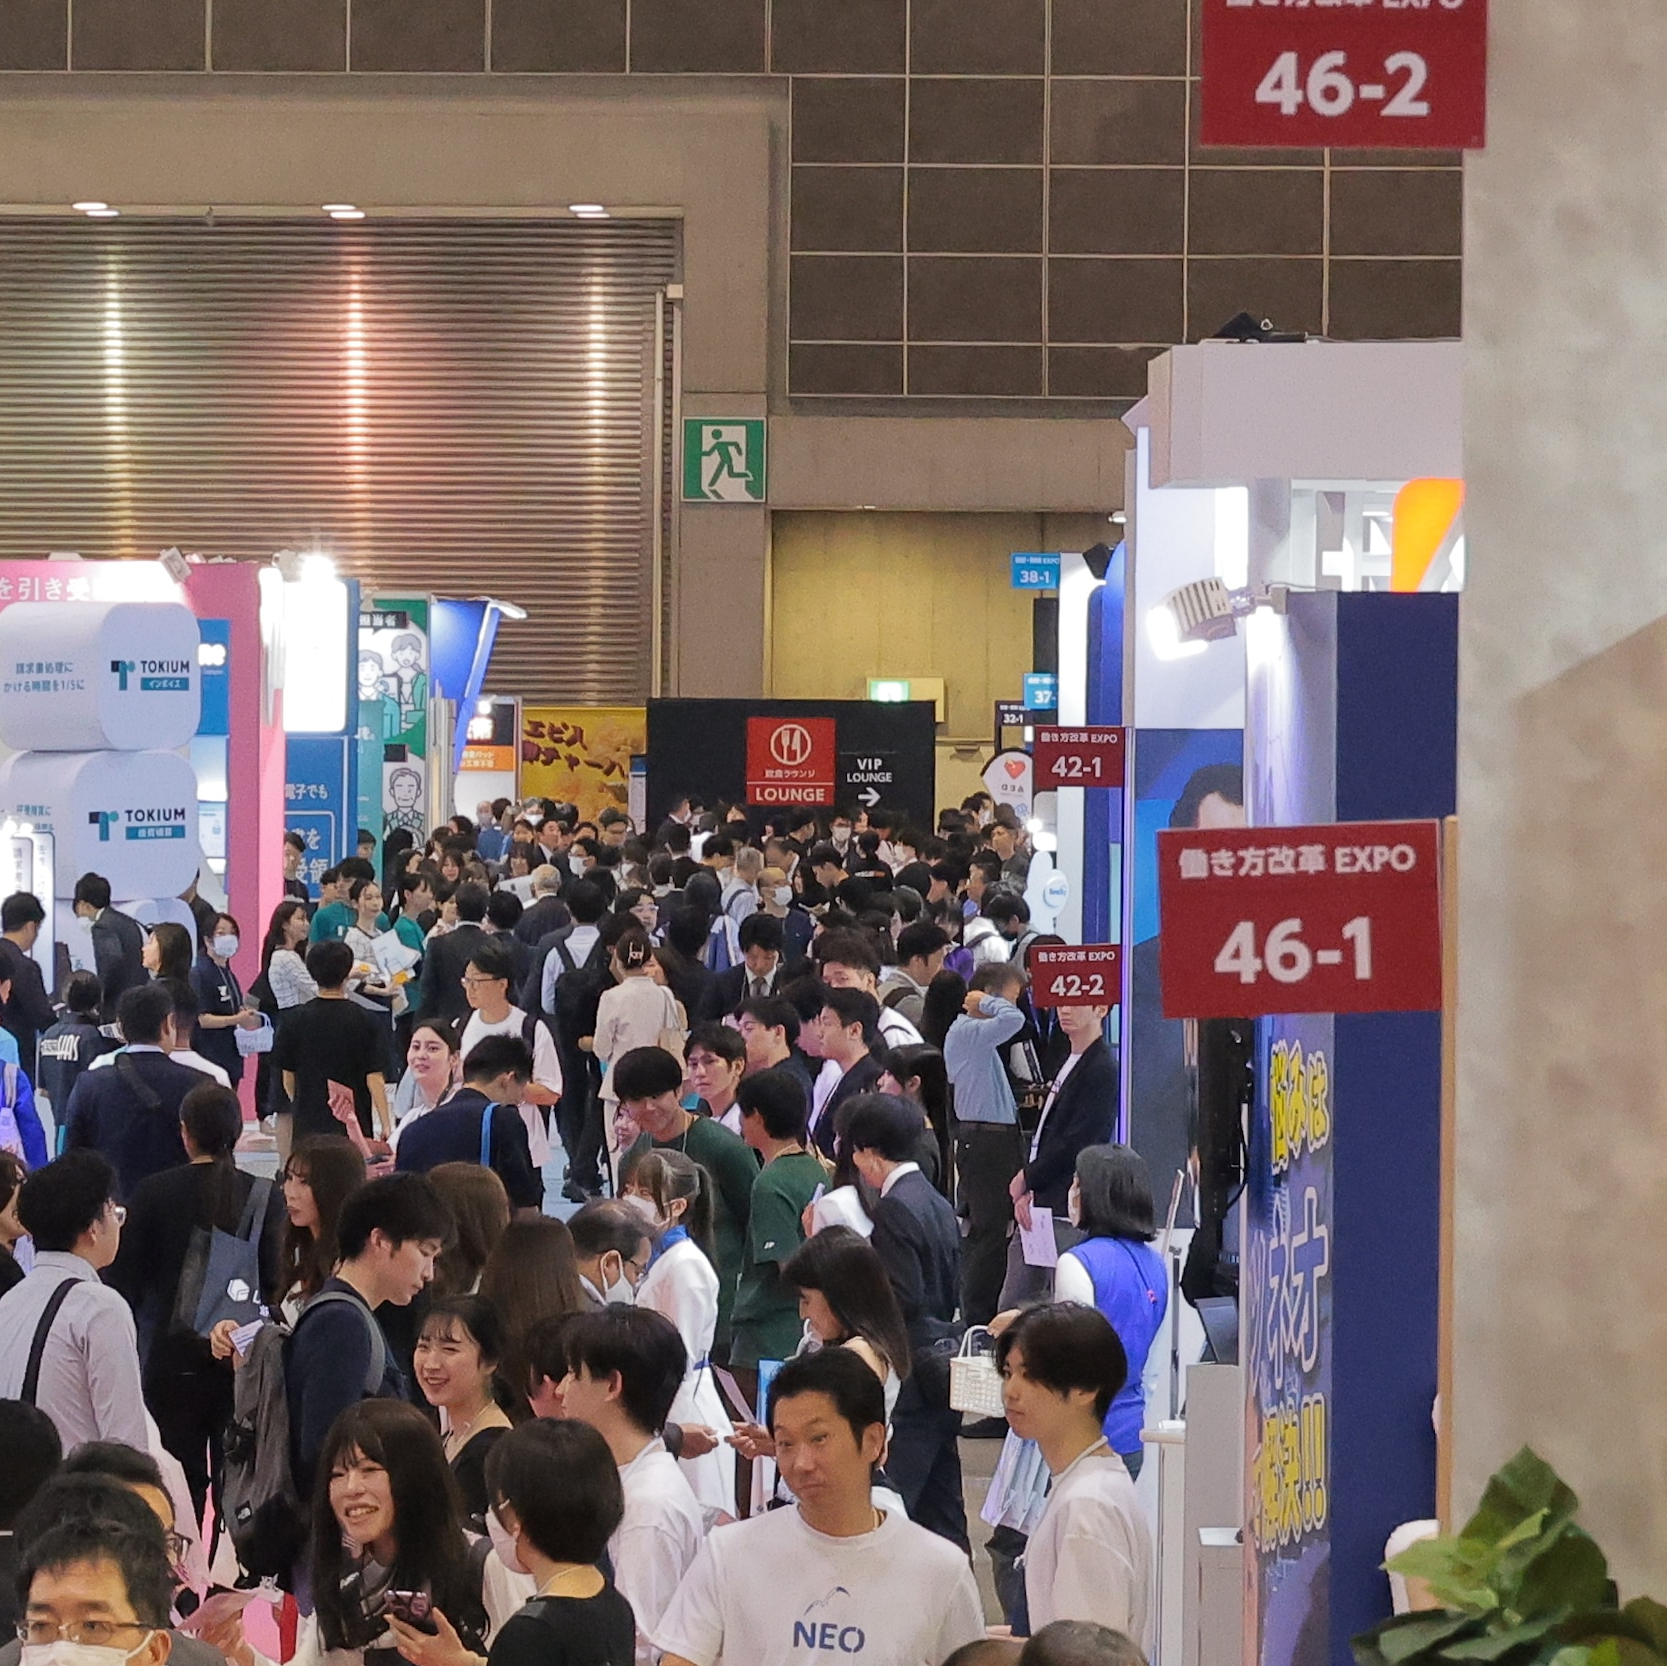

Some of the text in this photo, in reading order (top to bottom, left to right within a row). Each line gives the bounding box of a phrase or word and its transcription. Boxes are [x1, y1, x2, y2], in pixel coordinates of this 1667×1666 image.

[1255, 50, 1430, 117] 46-2
[140, 660, 190, 673] TOKIUM
[1034, 690, 1056, 703] 37-
[1003, 713, 1023, 723] 32-1
[1091, 734, 1117, 744] EXPO
[857, 758, 882, 770] VIP
[1051, 756, 1101, 778] 42-1
[847, 773, 892, 783] LOUNGE
[756, 788, 825, 801] LOUNGE
[125, 808, 186, 822] TOKIUM
[1179, 845, 1416, 880] 働き方改革 EXPO
[1038, 950, 1115, 962] 働き方改革 EXPO
[1214, 917, 1372, 984] 46-1
[1050, 974, 1104, 998] 42-2
[793, 1620, 865, 1654] NEO
